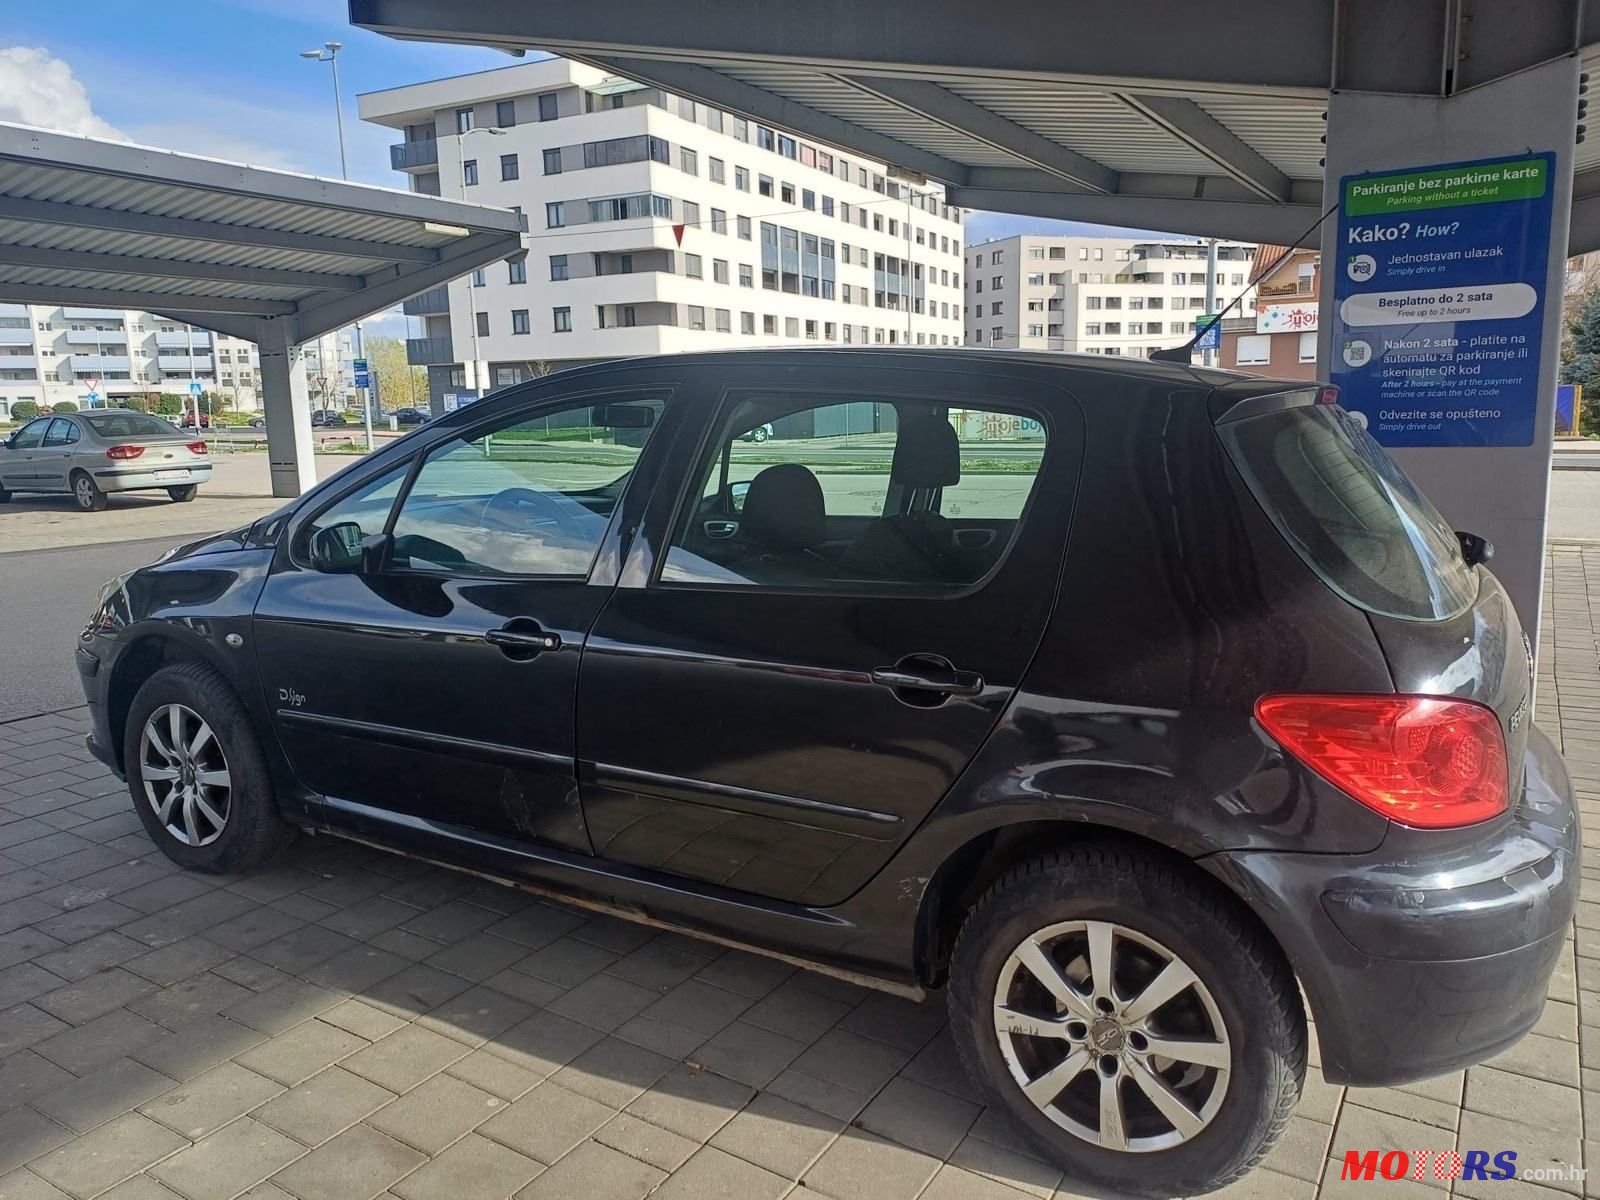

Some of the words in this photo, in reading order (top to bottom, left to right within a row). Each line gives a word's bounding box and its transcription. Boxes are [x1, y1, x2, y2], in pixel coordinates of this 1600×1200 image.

[1352, 182, 1415, 197] Parkiranje
[1419, 178, 1441, 190] bez
[1445, 172, 1499, 189] parkirne
[1503, 167, 1539, 180] karte
[1387, 195, 1422, 206] Parking
[1425, 191, 1459, 201] without
[1471, 186, 1499, 196] ticket
[1348, 223, 1410, 243] Kako?
[1416, 222, 1459, 238] How?
[1388, 251, 1461, 264] Jednostavan
[1464, 246, 1503, 259] ulazak
[1387, 268, 1414, 276] Simply
[1416, 266, 1436, 274] drive
[1378, 296, 1435, 308] Besplatno
[1438, 294, 1453, 304] do
[1456, 293, 1464, 303] 2
[1467, 292, 1493, 302] sata
[1417, 310, 1427, 318] up
[1429, 308, 1438, 316] to
[1446, 306, 1471, 315] hours
[1384, 339, 1420, 349] Nakon
[1423, 338, 1431, 348] 2
[1433, 337, 1459, 347] sata
[1470, 335, 1508, 348] platite
[1510, 336, 1526, 344] na
[1383, 353, 1436, 364] automatu
[1439, 353, 1453, 362] za
[1456, 350, 1515, 363] parkiranje
[1518, 348, 1528, 358] ili
[1382, 366, 1436, 378] skenirajte
[1439, 365, 1456, 376] QR
[1458, 364, 1481, 375] kod
[1441, 380, 1457, 388] pay
[1484, 377, 1522, 386] payment
[1478, 388, 1500, 396] code
[1379, 408, 1426, 419] Odvezite
[1430, 410, 1443, 419] se
[1446, 407, 1501, 420] opušteno
[1378, 423, 1404, 432] Simply
[1406, 422, 1426, 430] drive
[1427, 422, 1442, 430] out
